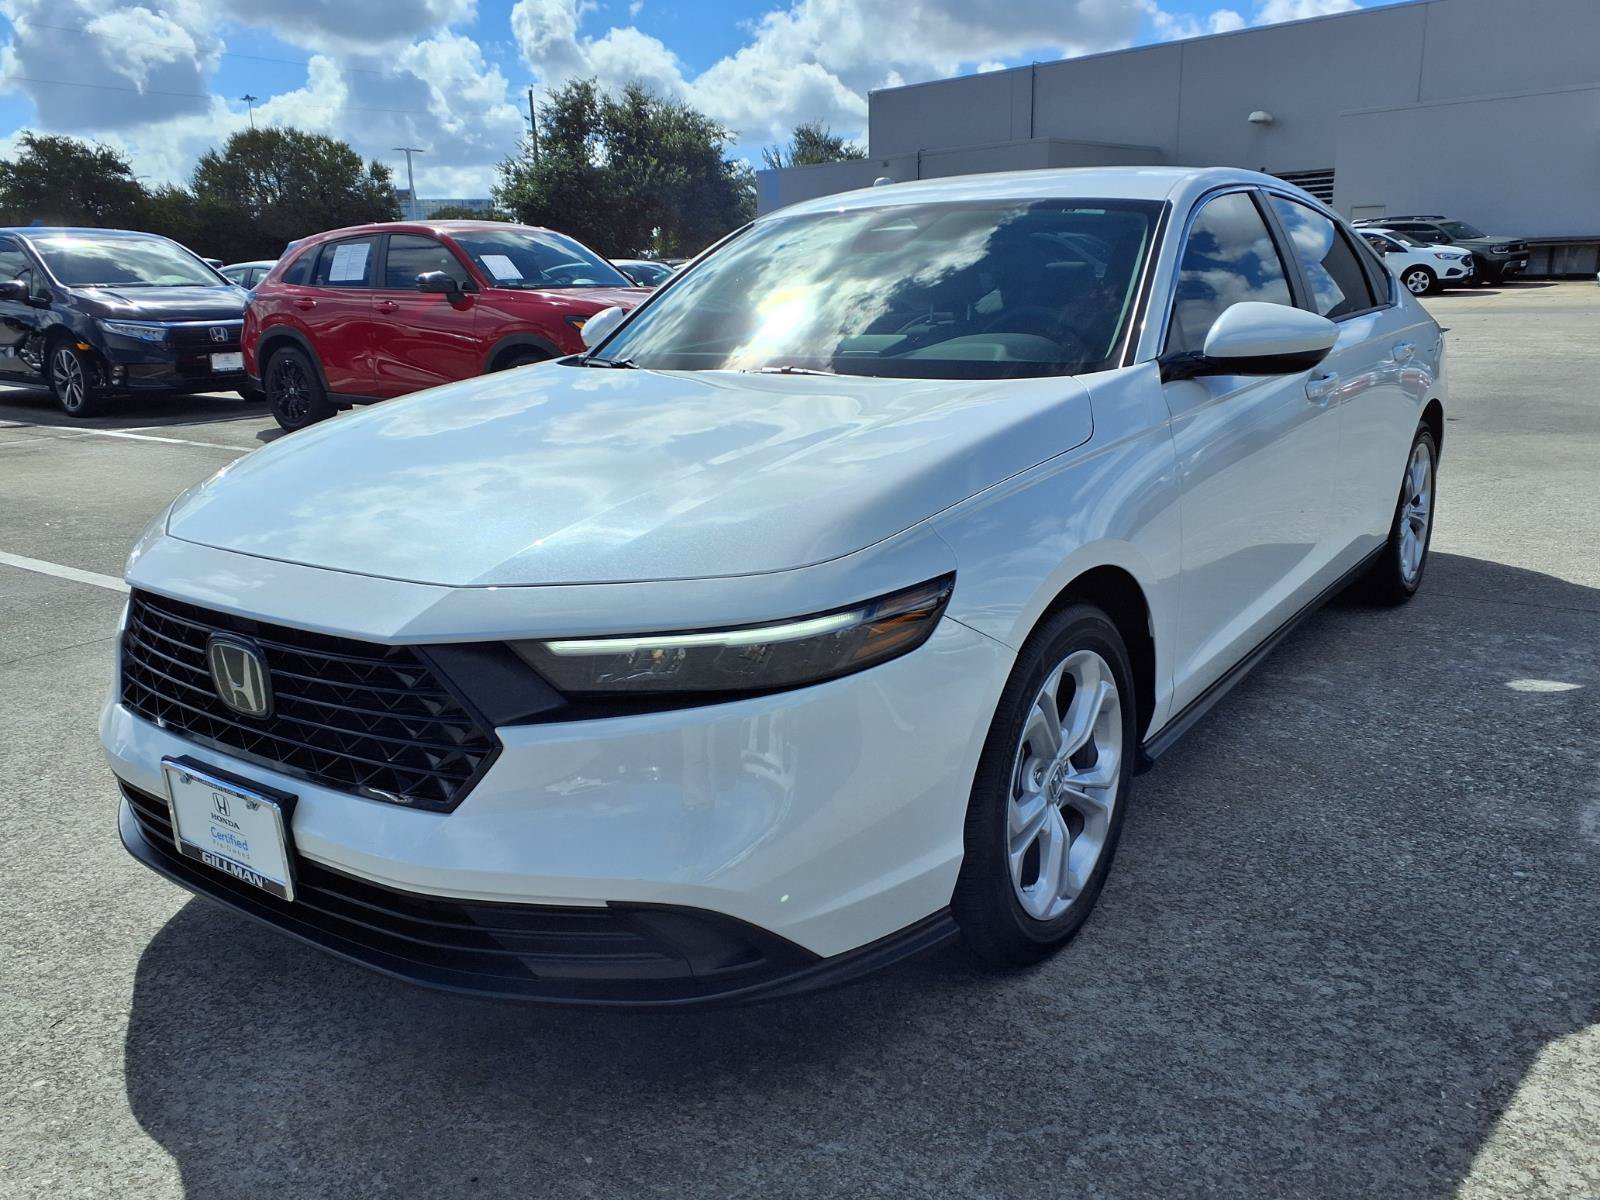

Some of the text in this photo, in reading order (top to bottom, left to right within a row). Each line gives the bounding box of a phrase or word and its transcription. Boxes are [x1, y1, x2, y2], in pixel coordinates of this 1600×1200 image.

[211, 812, 240, 830] HONDA
[211, 826, 249, 851] Certified
[201, 850, 264, 888] GILLMAN
